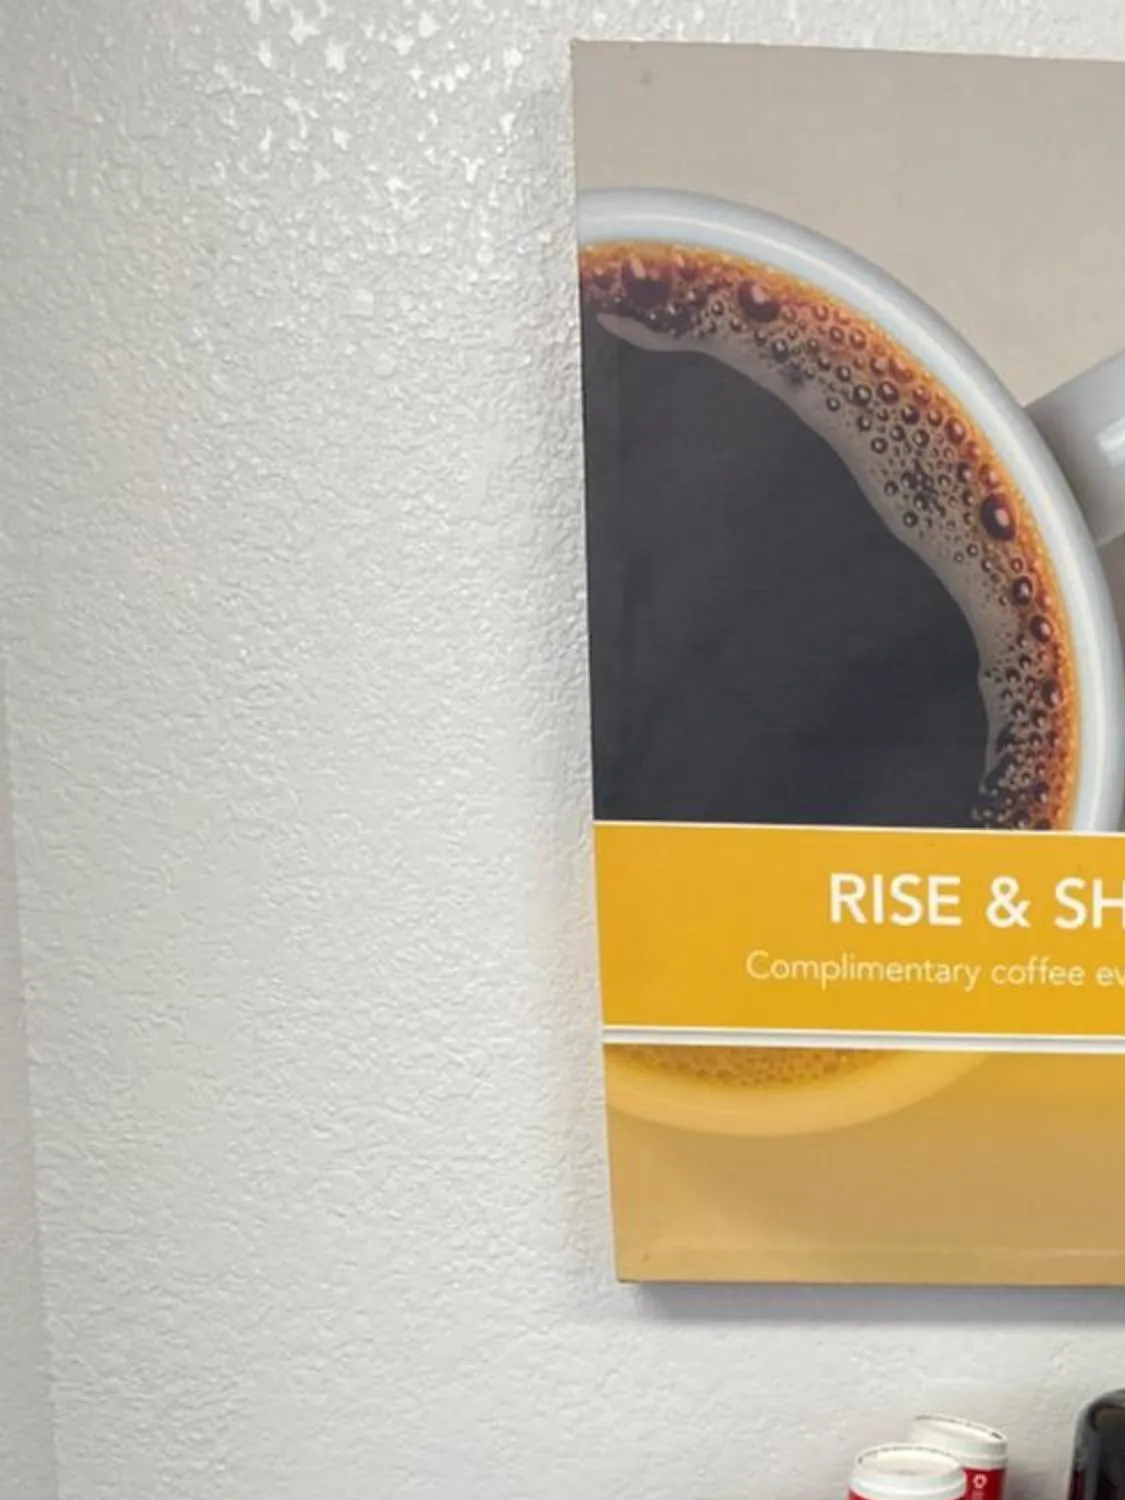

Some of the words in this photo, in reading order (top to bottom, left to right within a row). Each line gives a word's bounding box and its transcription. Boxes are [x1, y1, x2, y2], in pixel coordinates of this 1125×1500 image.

[829, 873, 962, 927] RISE
[985, 876, 1031, 929] &
[746, 950, 981, 993] Complimentary
[990, 957, 1085, 988] coffee
